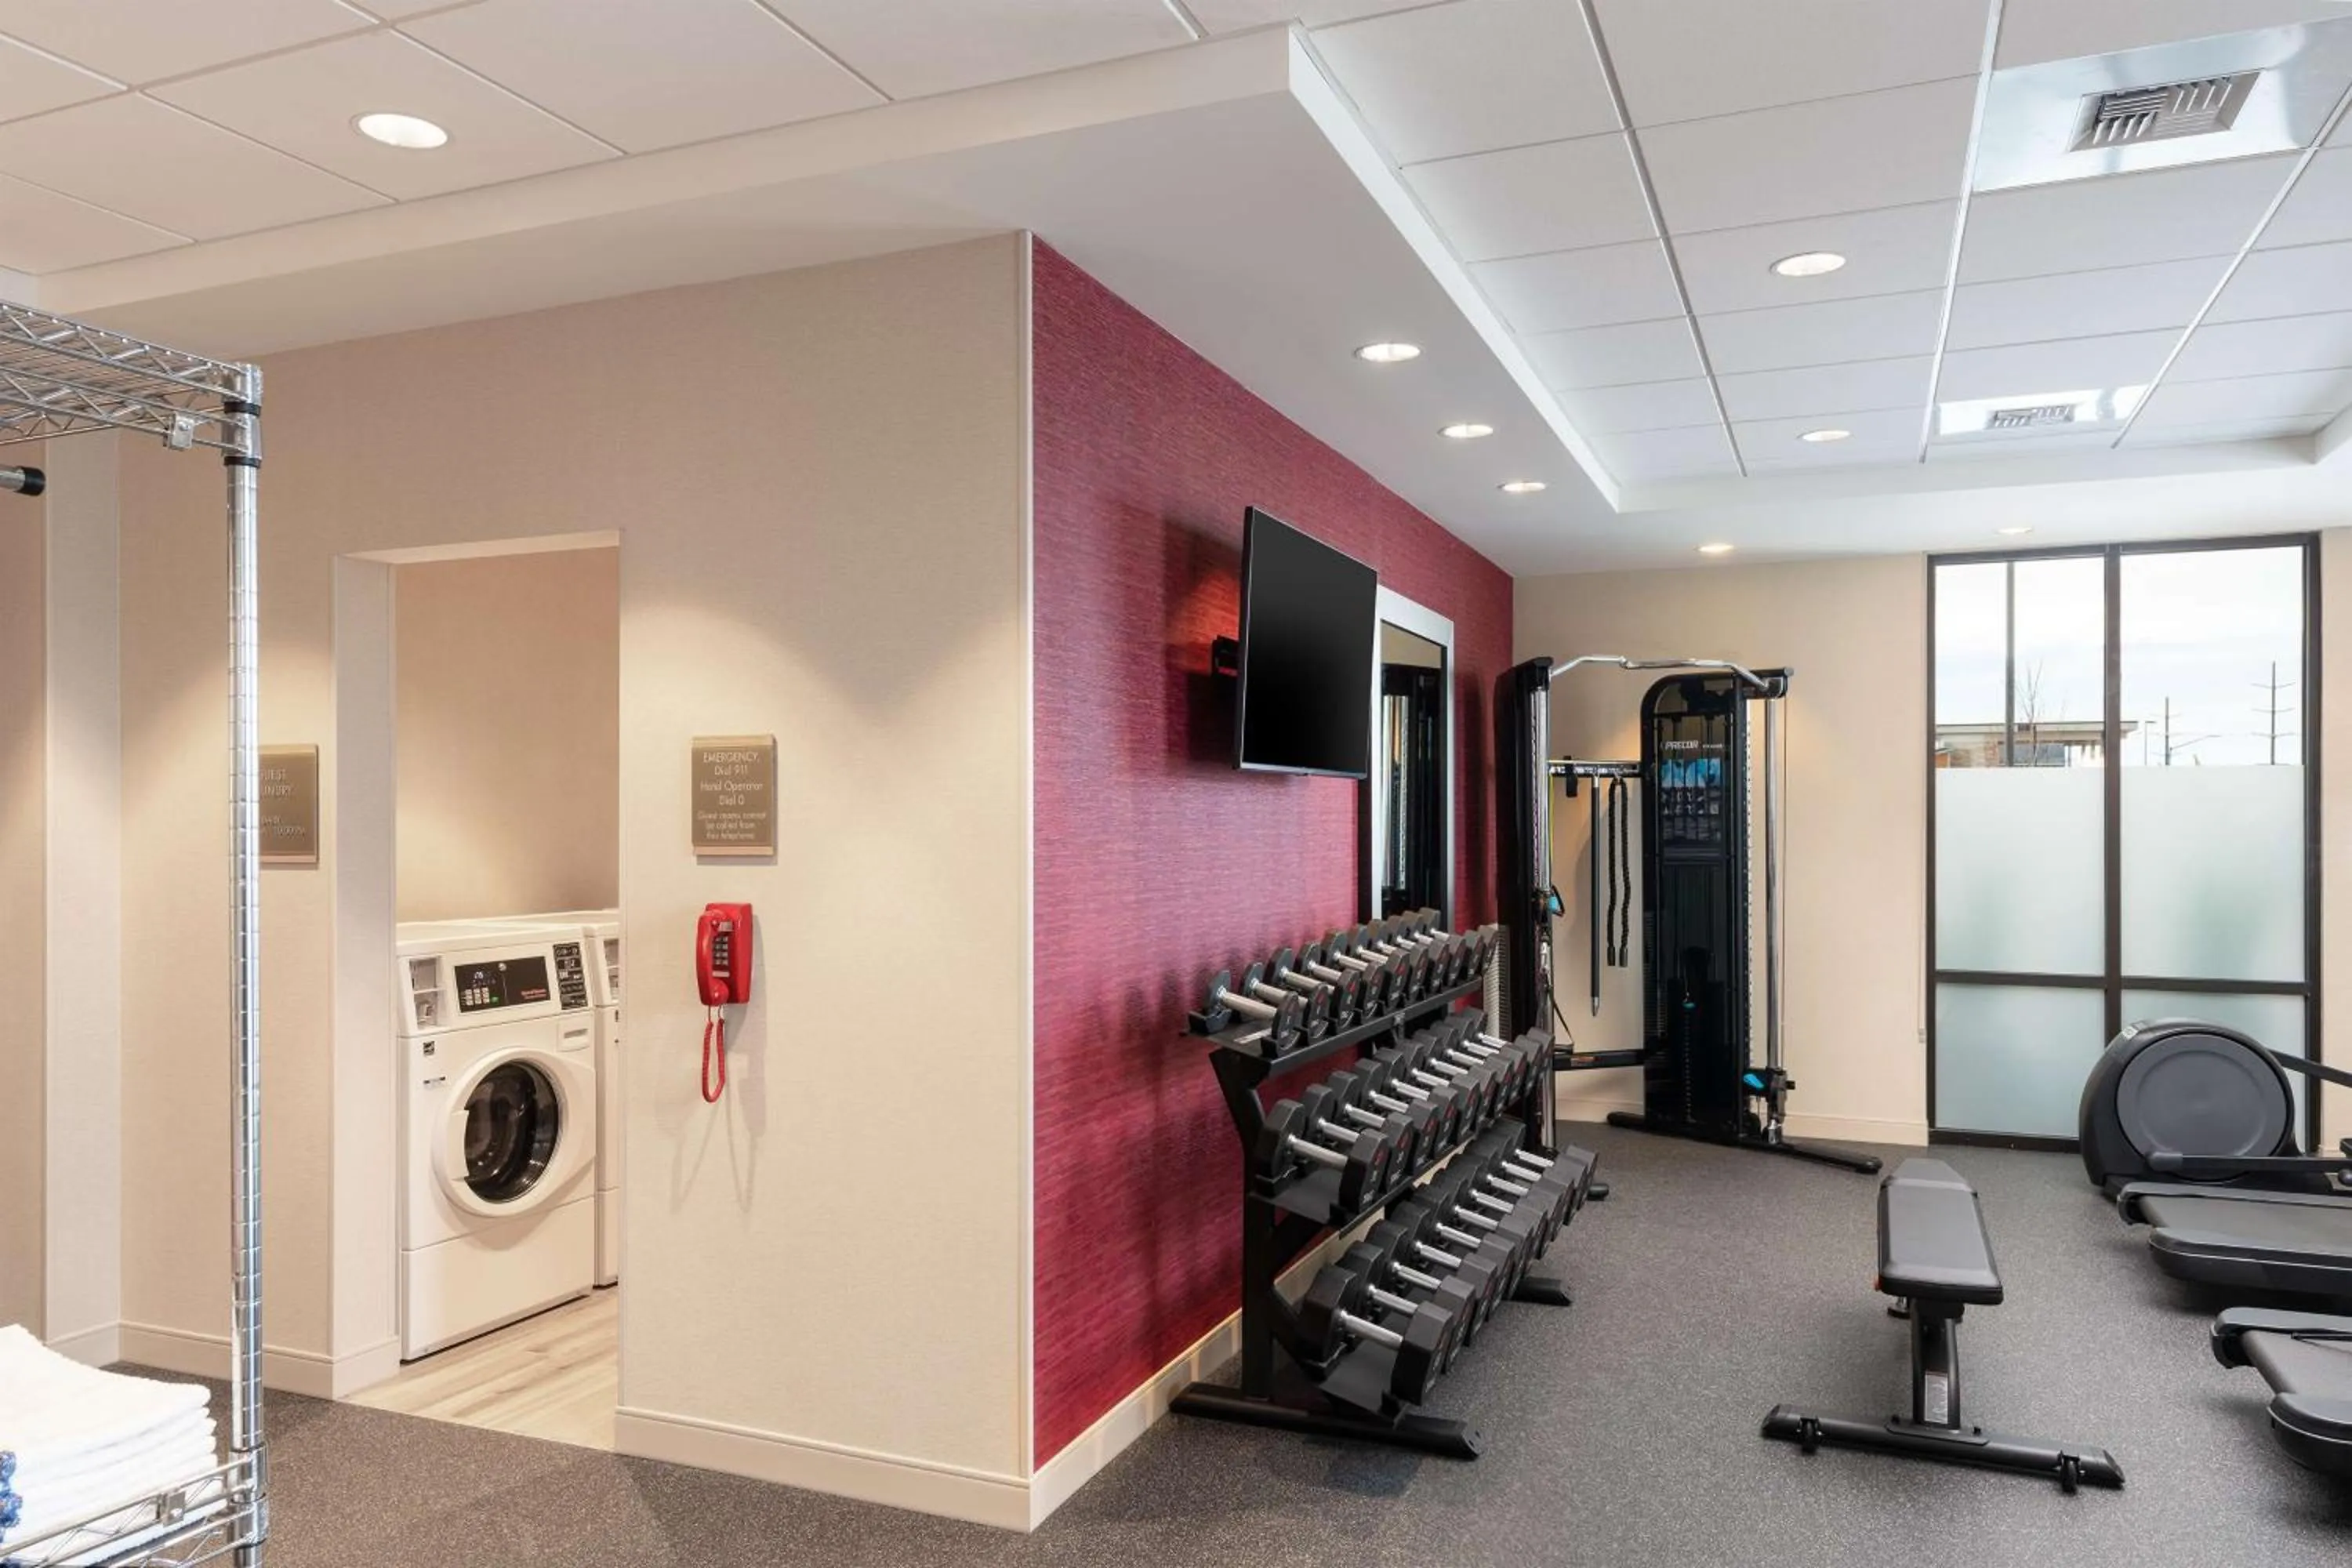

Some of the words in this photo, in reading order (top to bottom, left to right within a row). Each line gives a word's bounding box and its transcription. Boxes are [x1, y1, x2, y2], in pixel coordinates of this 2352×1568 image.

[1664, 740, 1699, 751] PRECOR
[714, 764, 731, 775] Dial
[734, 764, 748, 775] 911
[724, 780, 764, 793] Operator
[719, 794, 736, 806] Dial
[738, 794, 746, 806] 0
